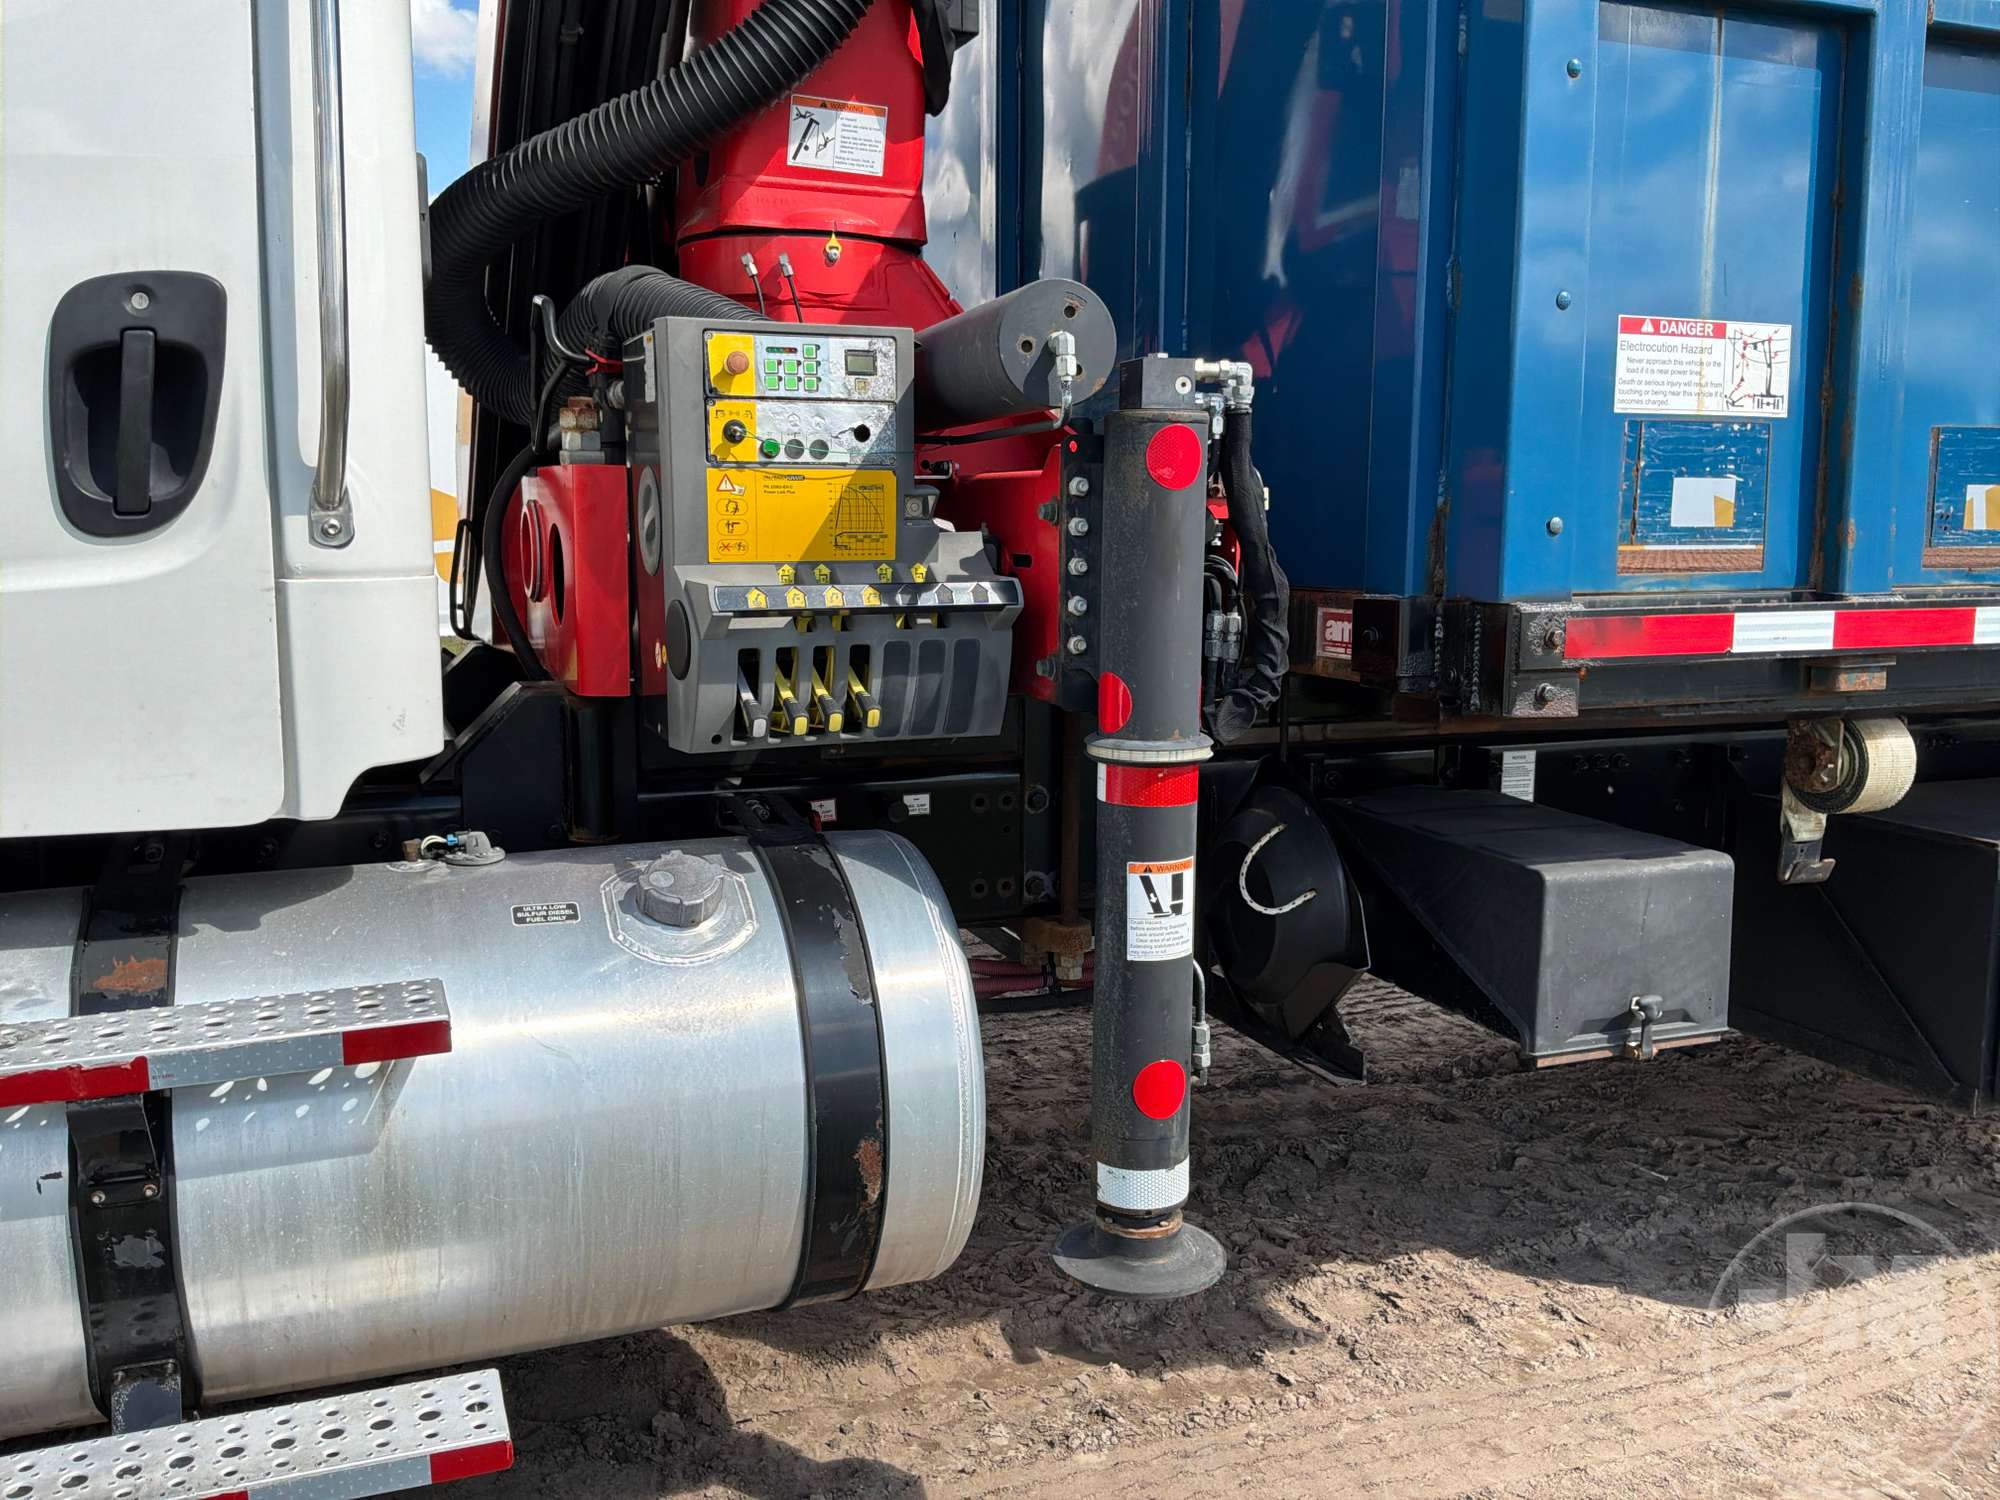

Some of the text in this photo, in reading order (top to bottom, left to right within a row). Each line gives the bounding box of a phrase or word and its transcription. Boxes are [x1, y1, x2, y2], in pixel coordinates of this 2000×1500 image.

[830, 102, 864, 112] WARNING
[1659, 320, 1714, 337] DANGER
[1619, 340, 1714, 356] Electrocution Hazard
[1626, 356, 1645, 365] Never
[1645, 358, 1673, 367] approach
[1673, 358, 1684, 367] this
[1712, 360, 1722, 368] the
[1670, 369, 1688, 378] power
[1618, 377, 1636, 386] Death
[1644, 379, 1665, 387] serious
[1666, 379, 1682, 389] injury
[1683, 380, 1692, 388] will
[1710, 380, 1723, 388] from
[1618, 388, 1643, 398] touching
[1651, 389, 1667, 398] being
[1682, 390, 1693, 398] this
[1617, 398, 1643, 406] becomes
[516, 910, 547, 918] SULFUR
